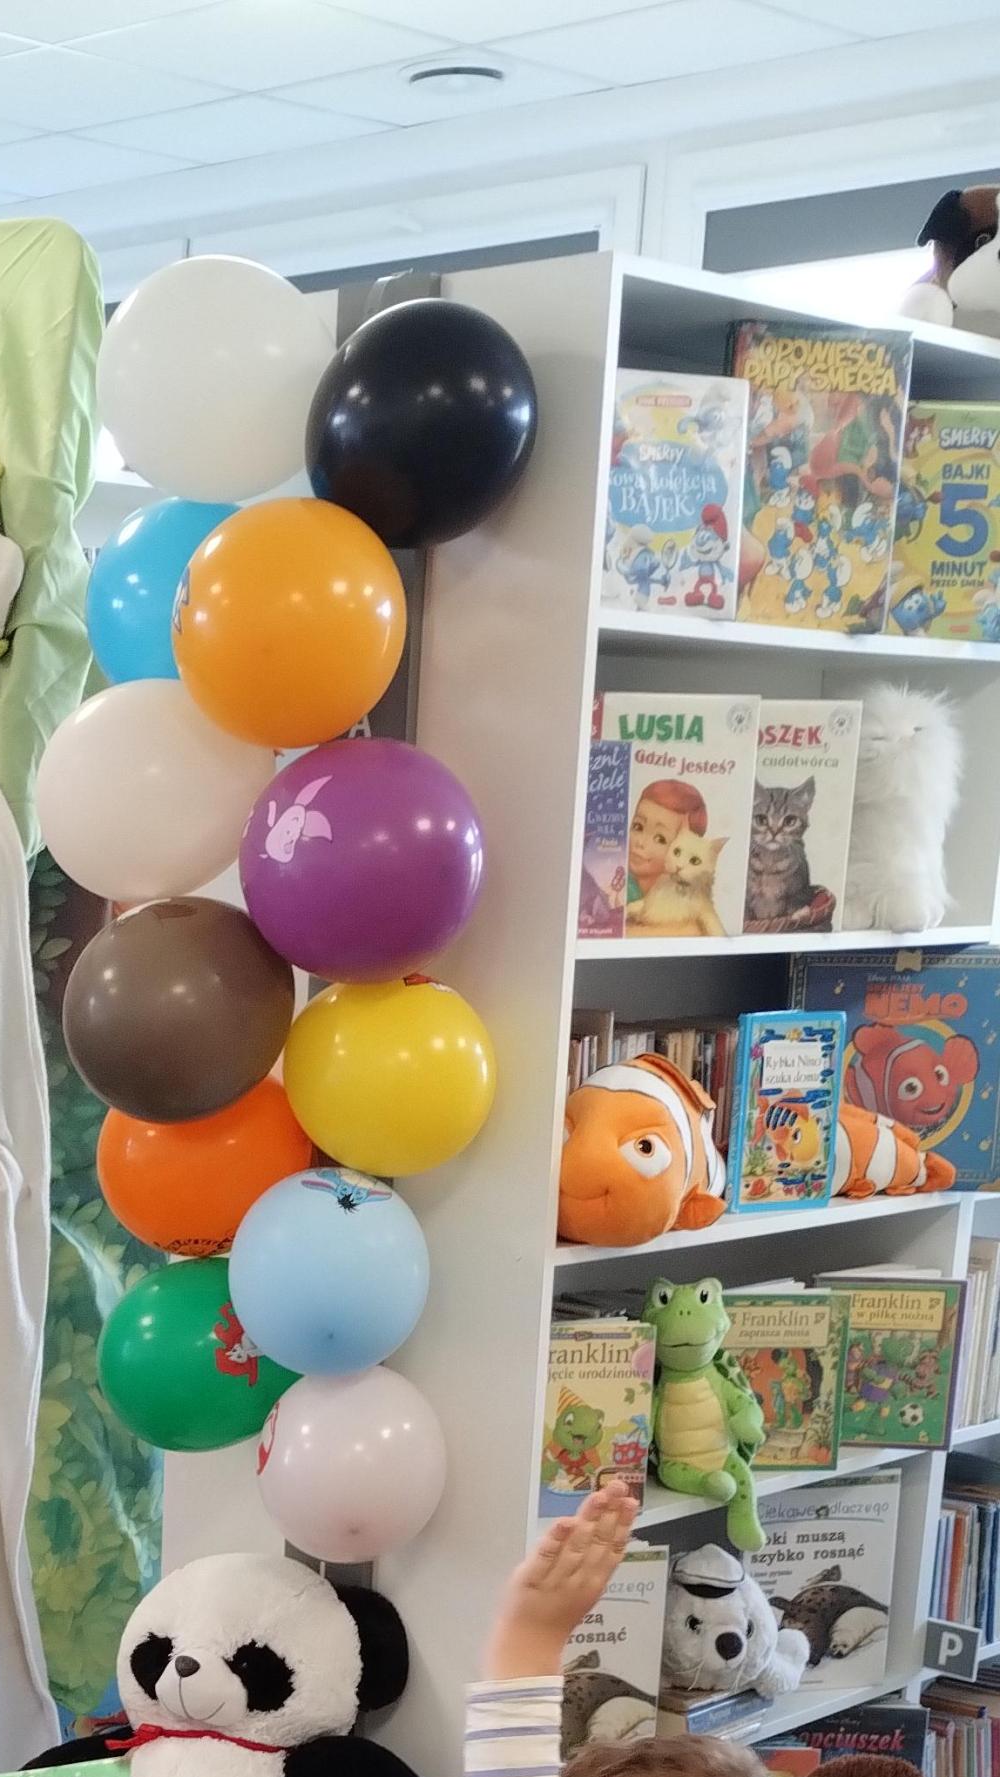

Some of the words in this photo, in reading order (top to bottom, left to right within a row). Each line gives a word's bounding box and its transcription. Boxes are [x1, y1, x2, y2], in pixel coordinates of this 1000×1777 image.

[809, 363, 897, 395] SMERFA
[940, 426, 998, 449] SMERFY
[942, 463, 991, 480] BAJKI
[620, 487, 695, 523] BAJEK
[936, 483, 989, 557] 5
[931, 560, 987, 577] MINUT
[618, 713, 704, 742] LUSIA
[634, 749, 676, 767] Gdzie
[678, 758, 736, 775] jesteś?
[762, 755, 840, 768] cudotwórca
[741, 1311, 809, 1327] Franklin
[548, 1342, 631, 1365] ranklin
[578, 1366, 650, 1380] urodzinowe
[830, 1501, 889, 1517] dlaczego
[796, 1531, 846, 1544] muszą
[751, 1548, 805, 1565] szybko
[813, 1544, 865, 1561] rosnąć
[937, 1631, 964, 1666] P
[800, 1728, 906, 1751] opciuszek
